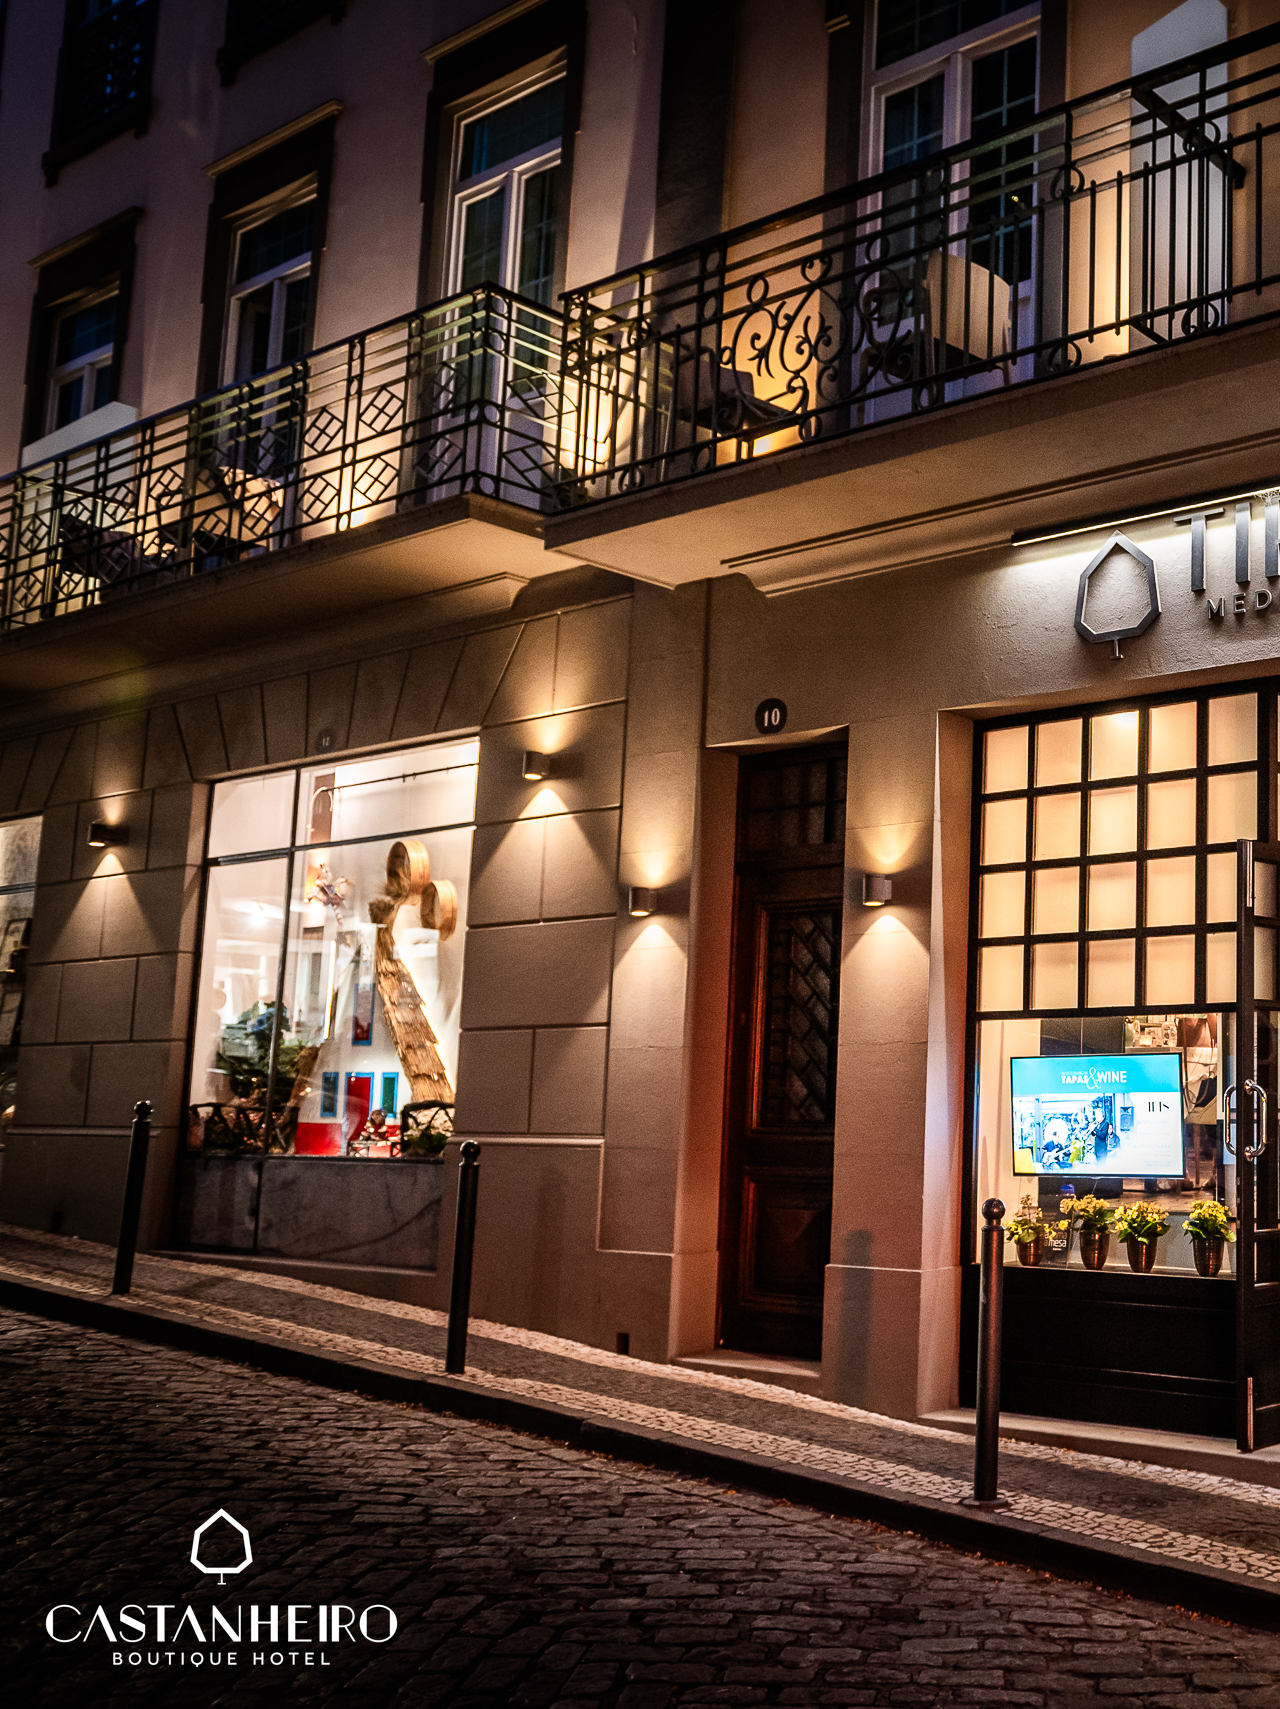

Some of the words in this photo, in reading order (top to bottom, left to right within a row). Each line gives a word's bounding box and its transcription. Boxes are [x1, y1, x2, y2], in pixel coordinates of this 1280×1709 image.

[763, 708, 780, 727] 10
[1061, 1075, 1089, 1084] TAPAS
[1097, 1071, 1127, 1083] WINE
